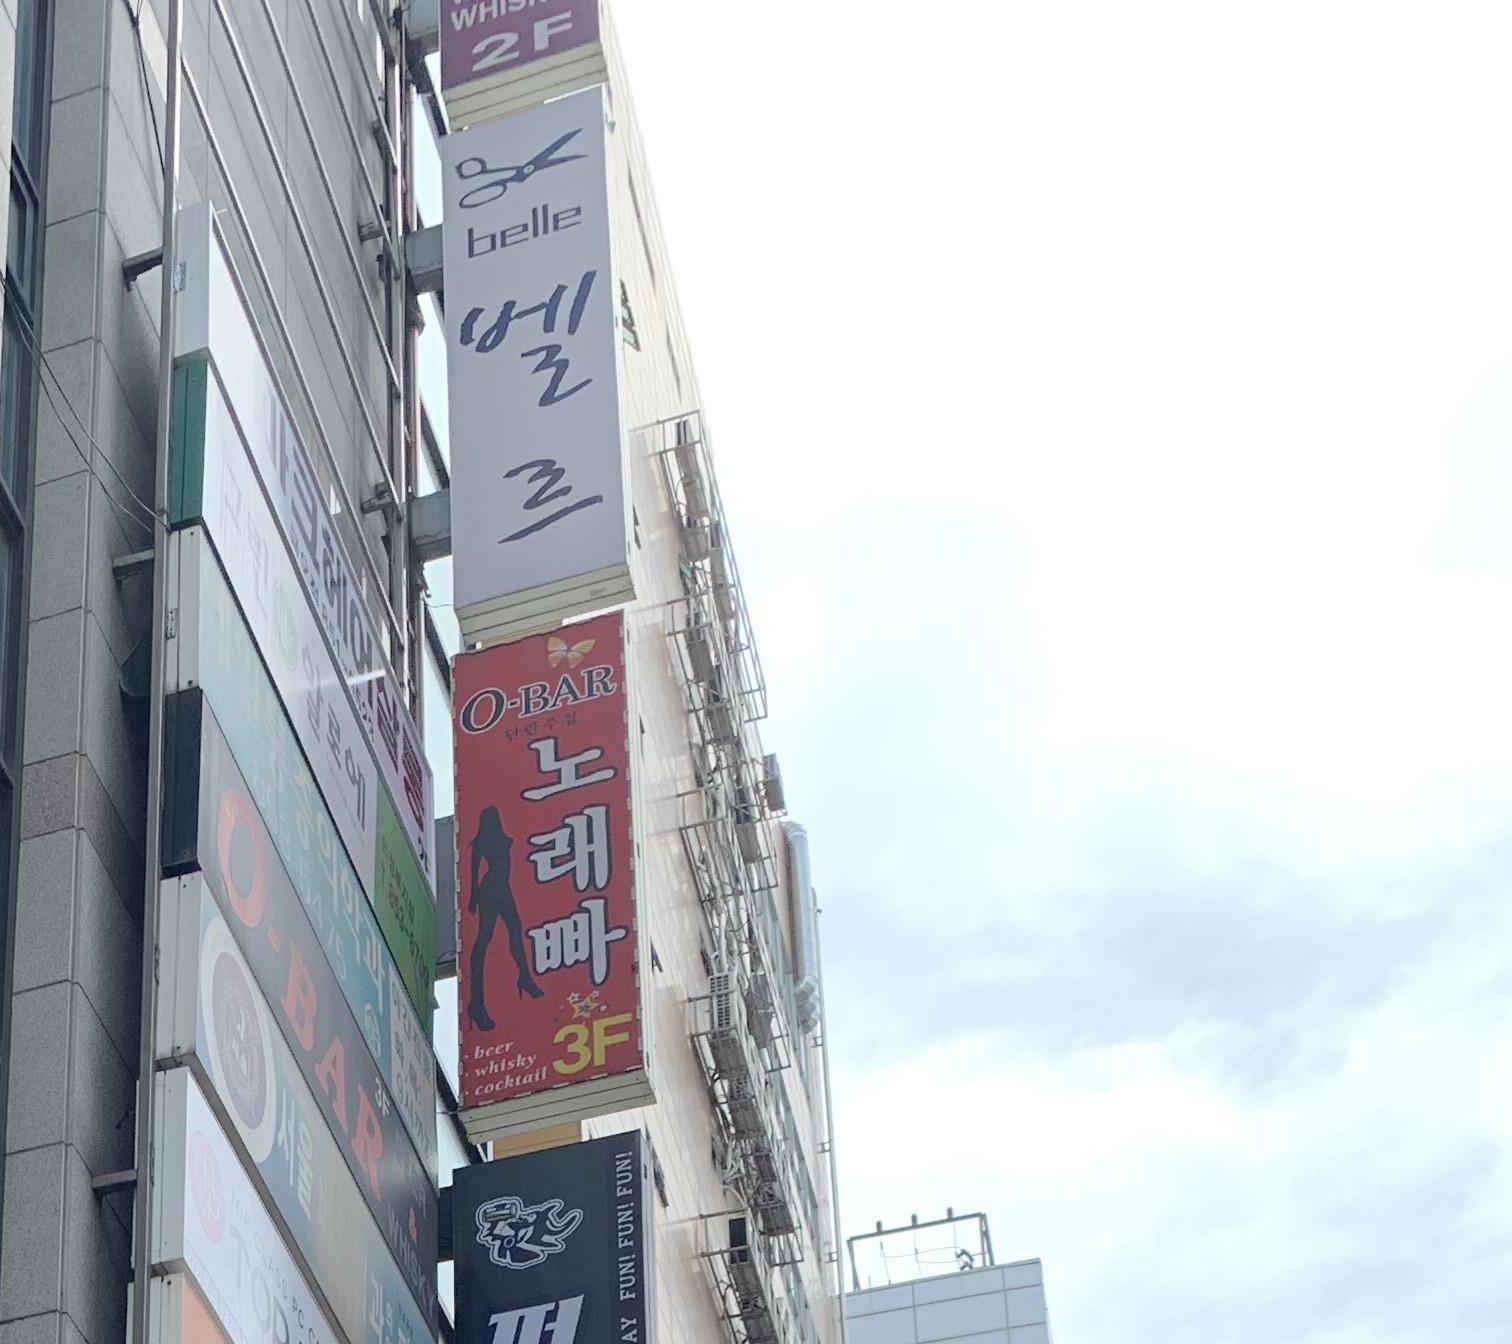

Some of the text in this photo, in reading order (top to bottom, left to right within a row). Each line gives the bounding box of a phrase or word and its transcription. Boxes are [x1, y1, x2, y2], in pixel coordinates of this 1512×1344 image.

[472, 12, 574, 73] 2F
[468, 204, 581, 258] belle
[460, 665, 617, 734] O-BAR
[524, 737, 627, 986] 노래빠
[473, 1038, 514, 1059] beer
[475, 1055, 537, 1079] whisky
[552, 1012, 633, 1075] 3F
[475, 1069, 547, 1097] cocktail
[616, 1150, 634, 1202] FUN!
[619, 1204, 635, 1254] FUN!
[620, 1254, 637, 1302] FUN!
